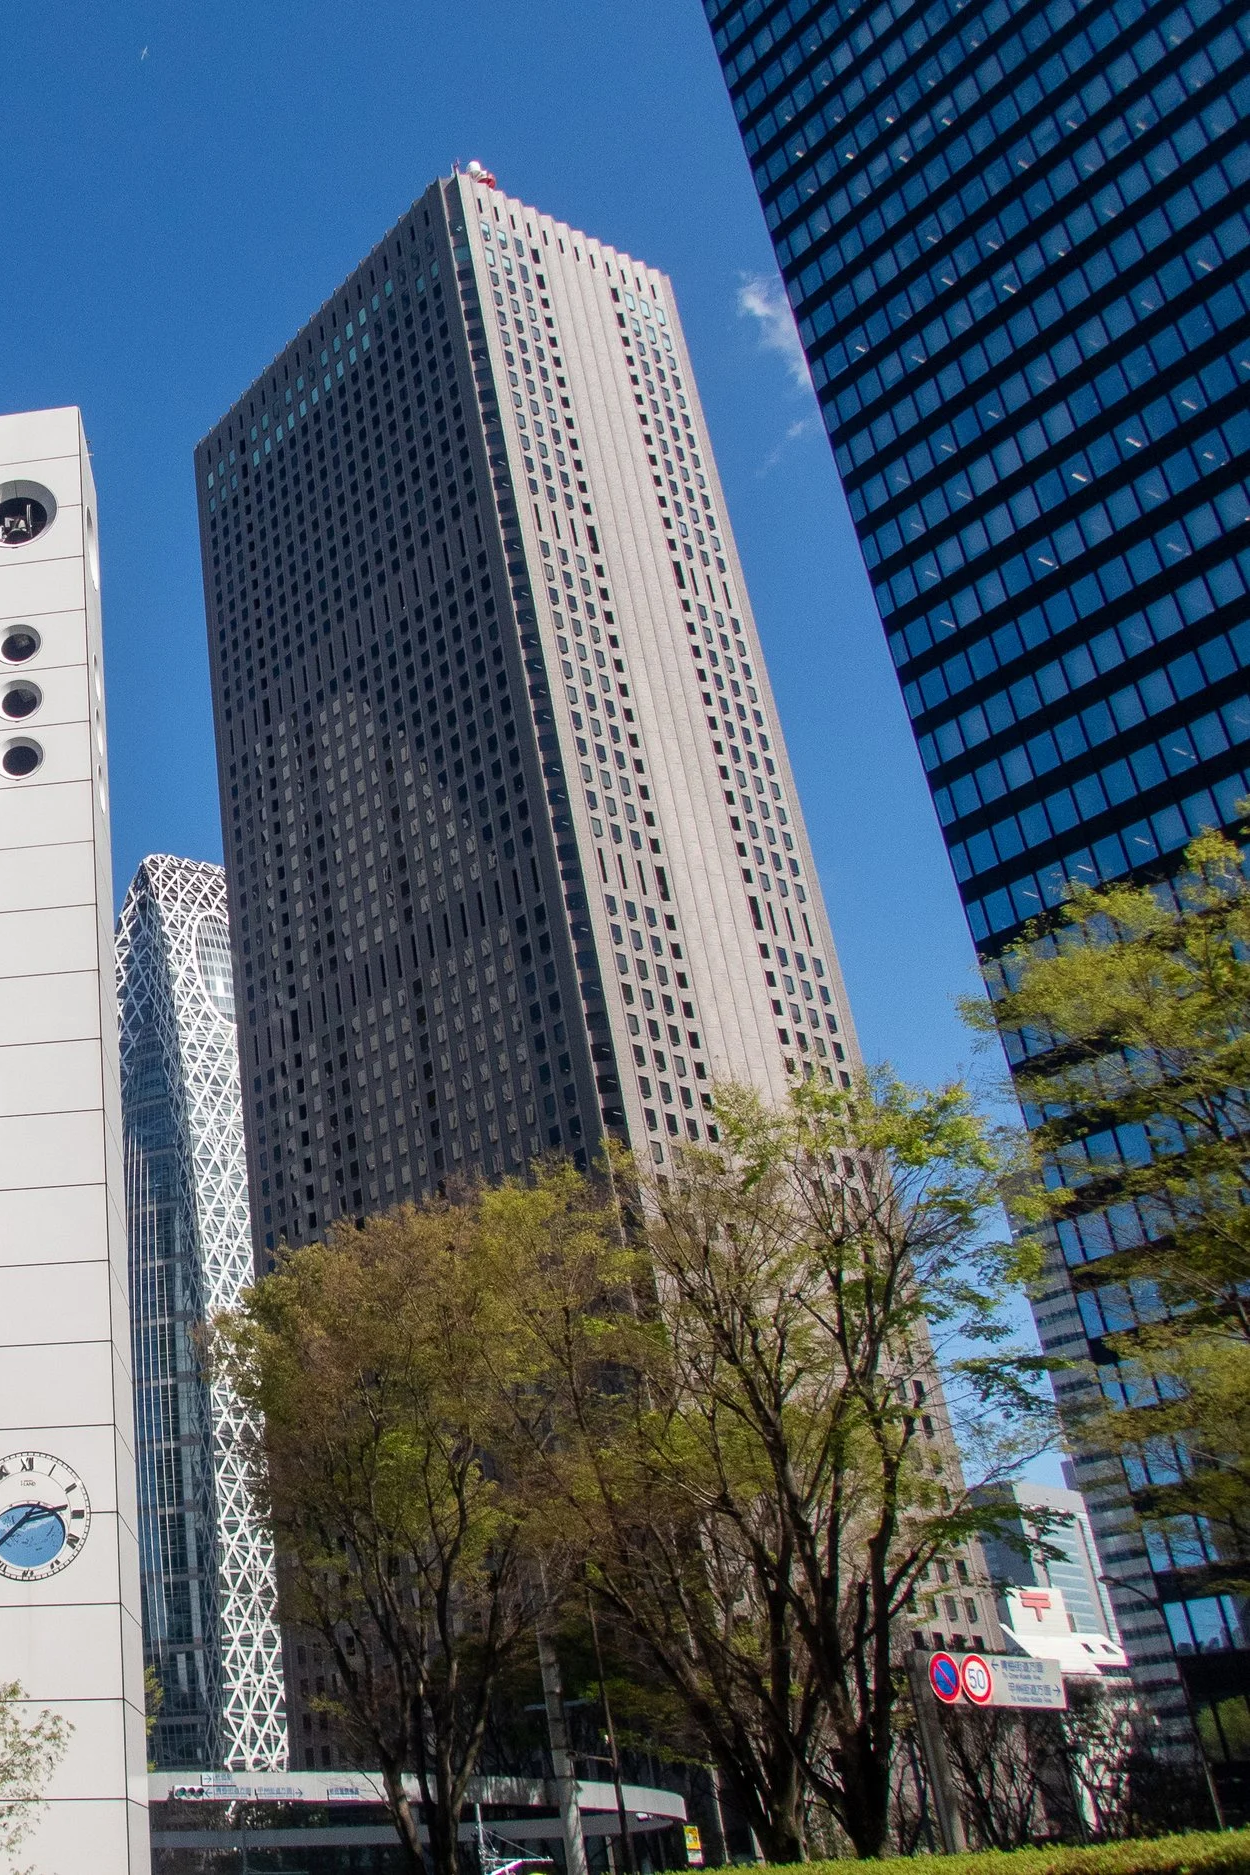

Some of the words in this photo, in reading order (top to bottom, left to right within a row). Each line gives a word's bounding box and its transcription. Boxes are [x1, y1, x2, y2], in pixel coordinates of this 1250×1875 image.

[21, 1457, 34, 1471] XII
[65, 1483, 77, 1494] II
[71, 1509, 85, 1519] III
[967, 1668, 986, 1690] 50
